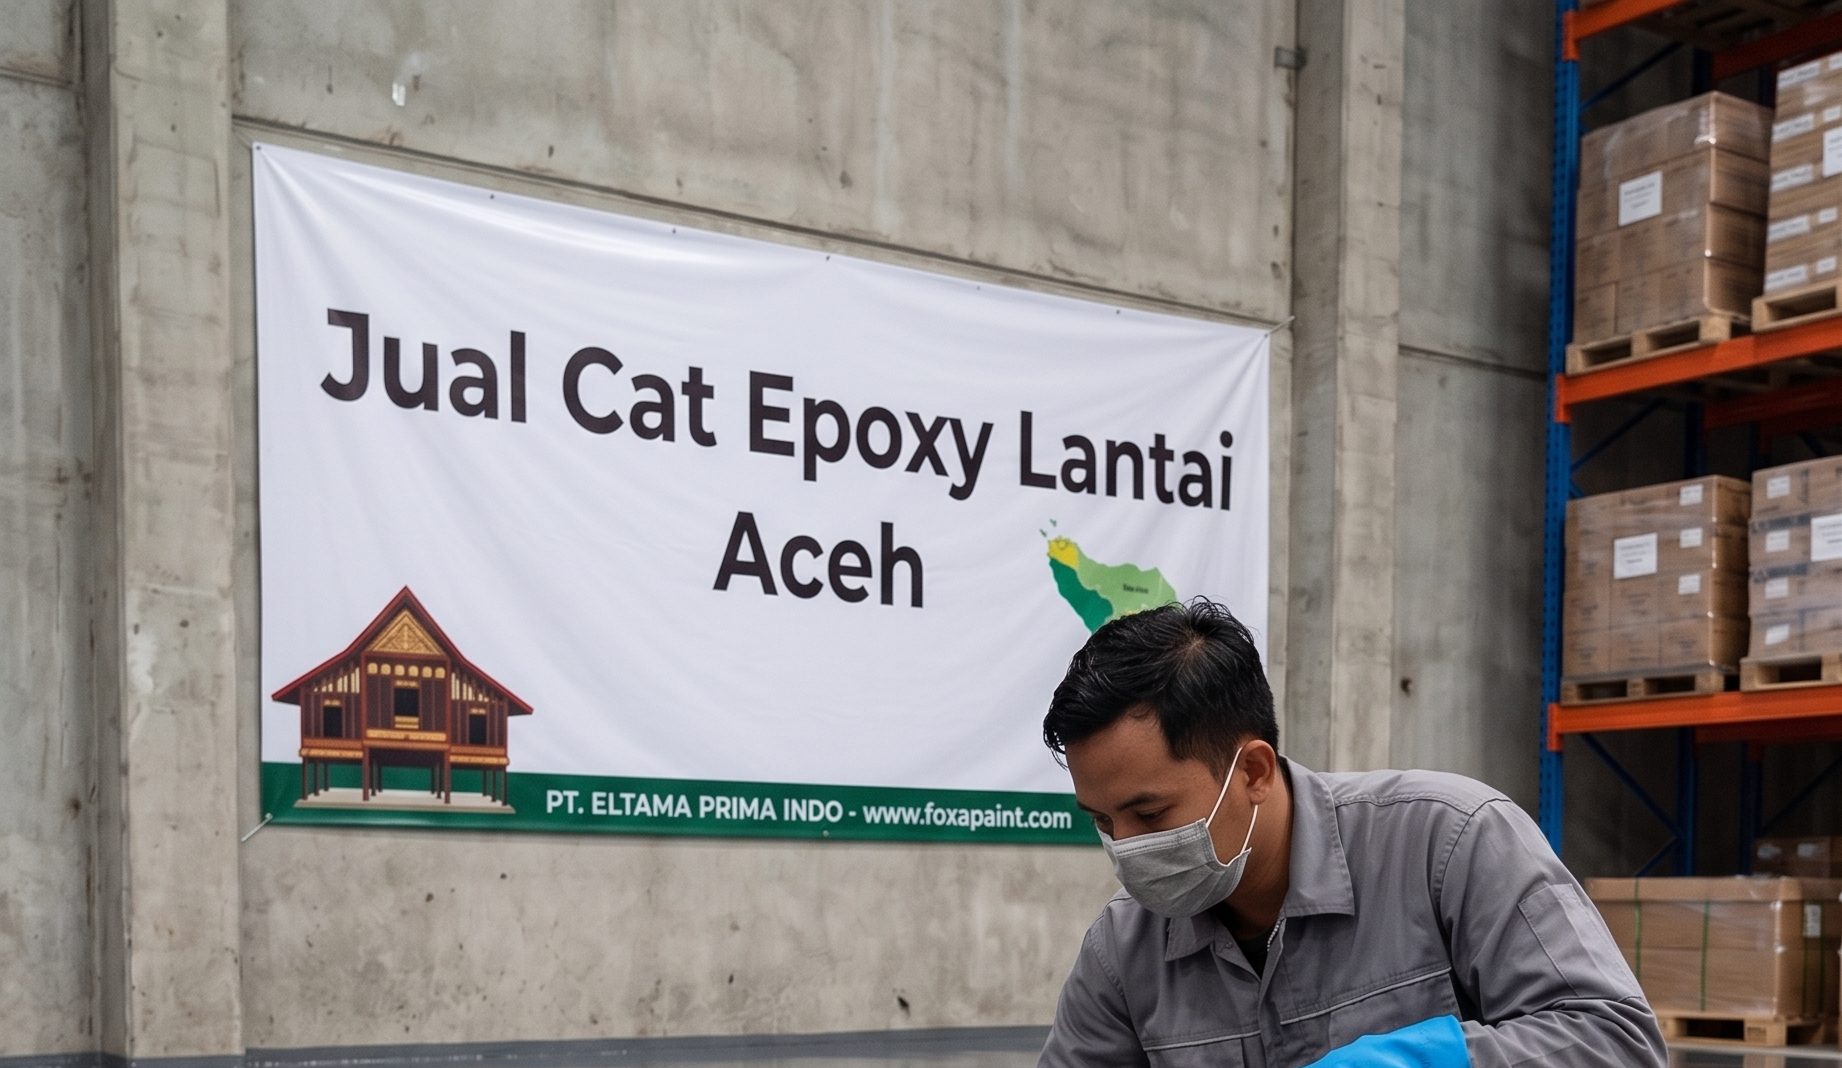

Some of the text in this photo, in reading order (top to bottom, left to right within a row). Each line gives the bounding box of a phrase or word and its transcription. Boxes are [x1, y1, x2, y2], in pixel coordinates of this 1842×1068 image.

[320, 308, 1234, 511] Jual Cat Epoxy Lantai
[713, 511, 924, 608] Aceh
[546, 790, 584, 814] PT.
[591, 791, 692, 818] ELTAMA
[699, 795, 777, 821] PRIMA
[784, 799, 843, 823] INDO
[863, 802, 1072, 831] www.foxapaint.com
